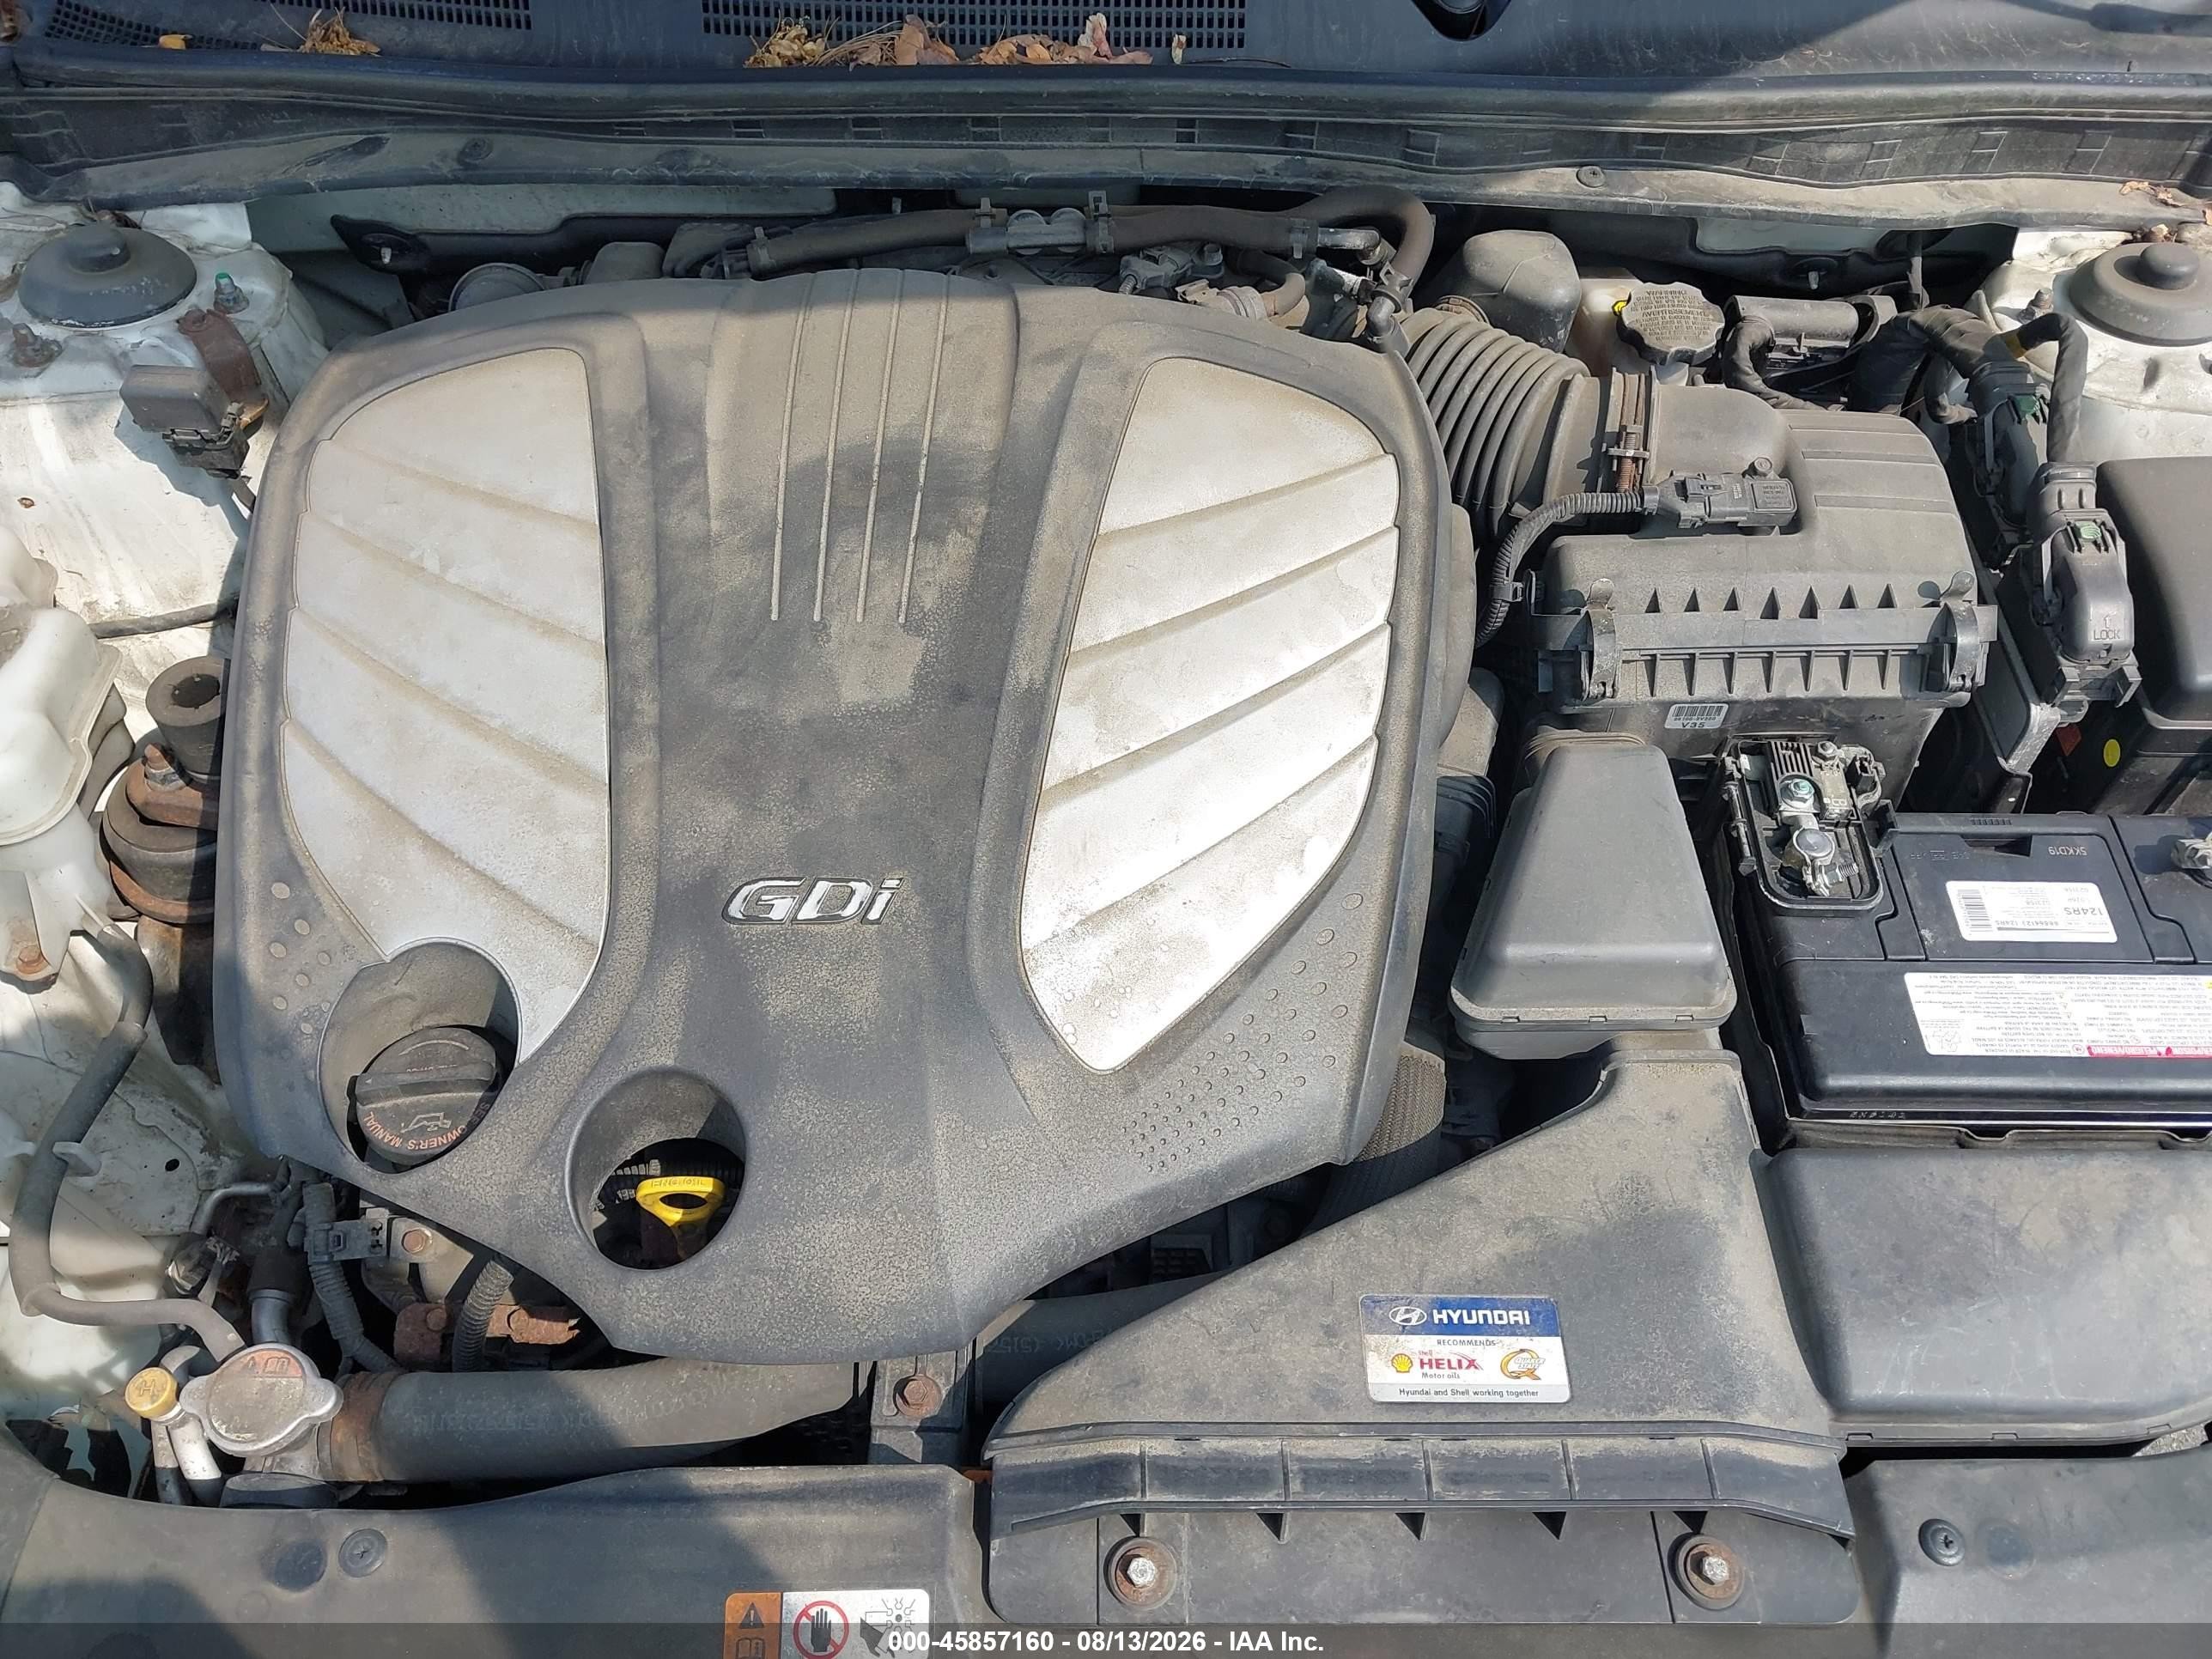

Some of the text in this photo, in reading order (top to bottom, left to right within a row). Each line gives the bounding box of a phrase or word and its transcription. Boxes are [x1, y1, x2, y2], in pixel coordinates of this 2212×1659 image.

[2094, 629, 2120, 641] LOCK
[721, 876, 904, 925] GDi
[2063, 907, 2104, 915] 124RS
[363, 1102, 490, 1151] SEE OWNER'S MANUAL
[1432, 1309, 1531, 1326] HYUNDAI
[1419, 1358, 1482, 1370] HELIX
[1399, 1388, 1431, 1398] Hyundai
[1472, 1389, 1504, 1398] working
[1506, 1389, 1539, 1398] together
